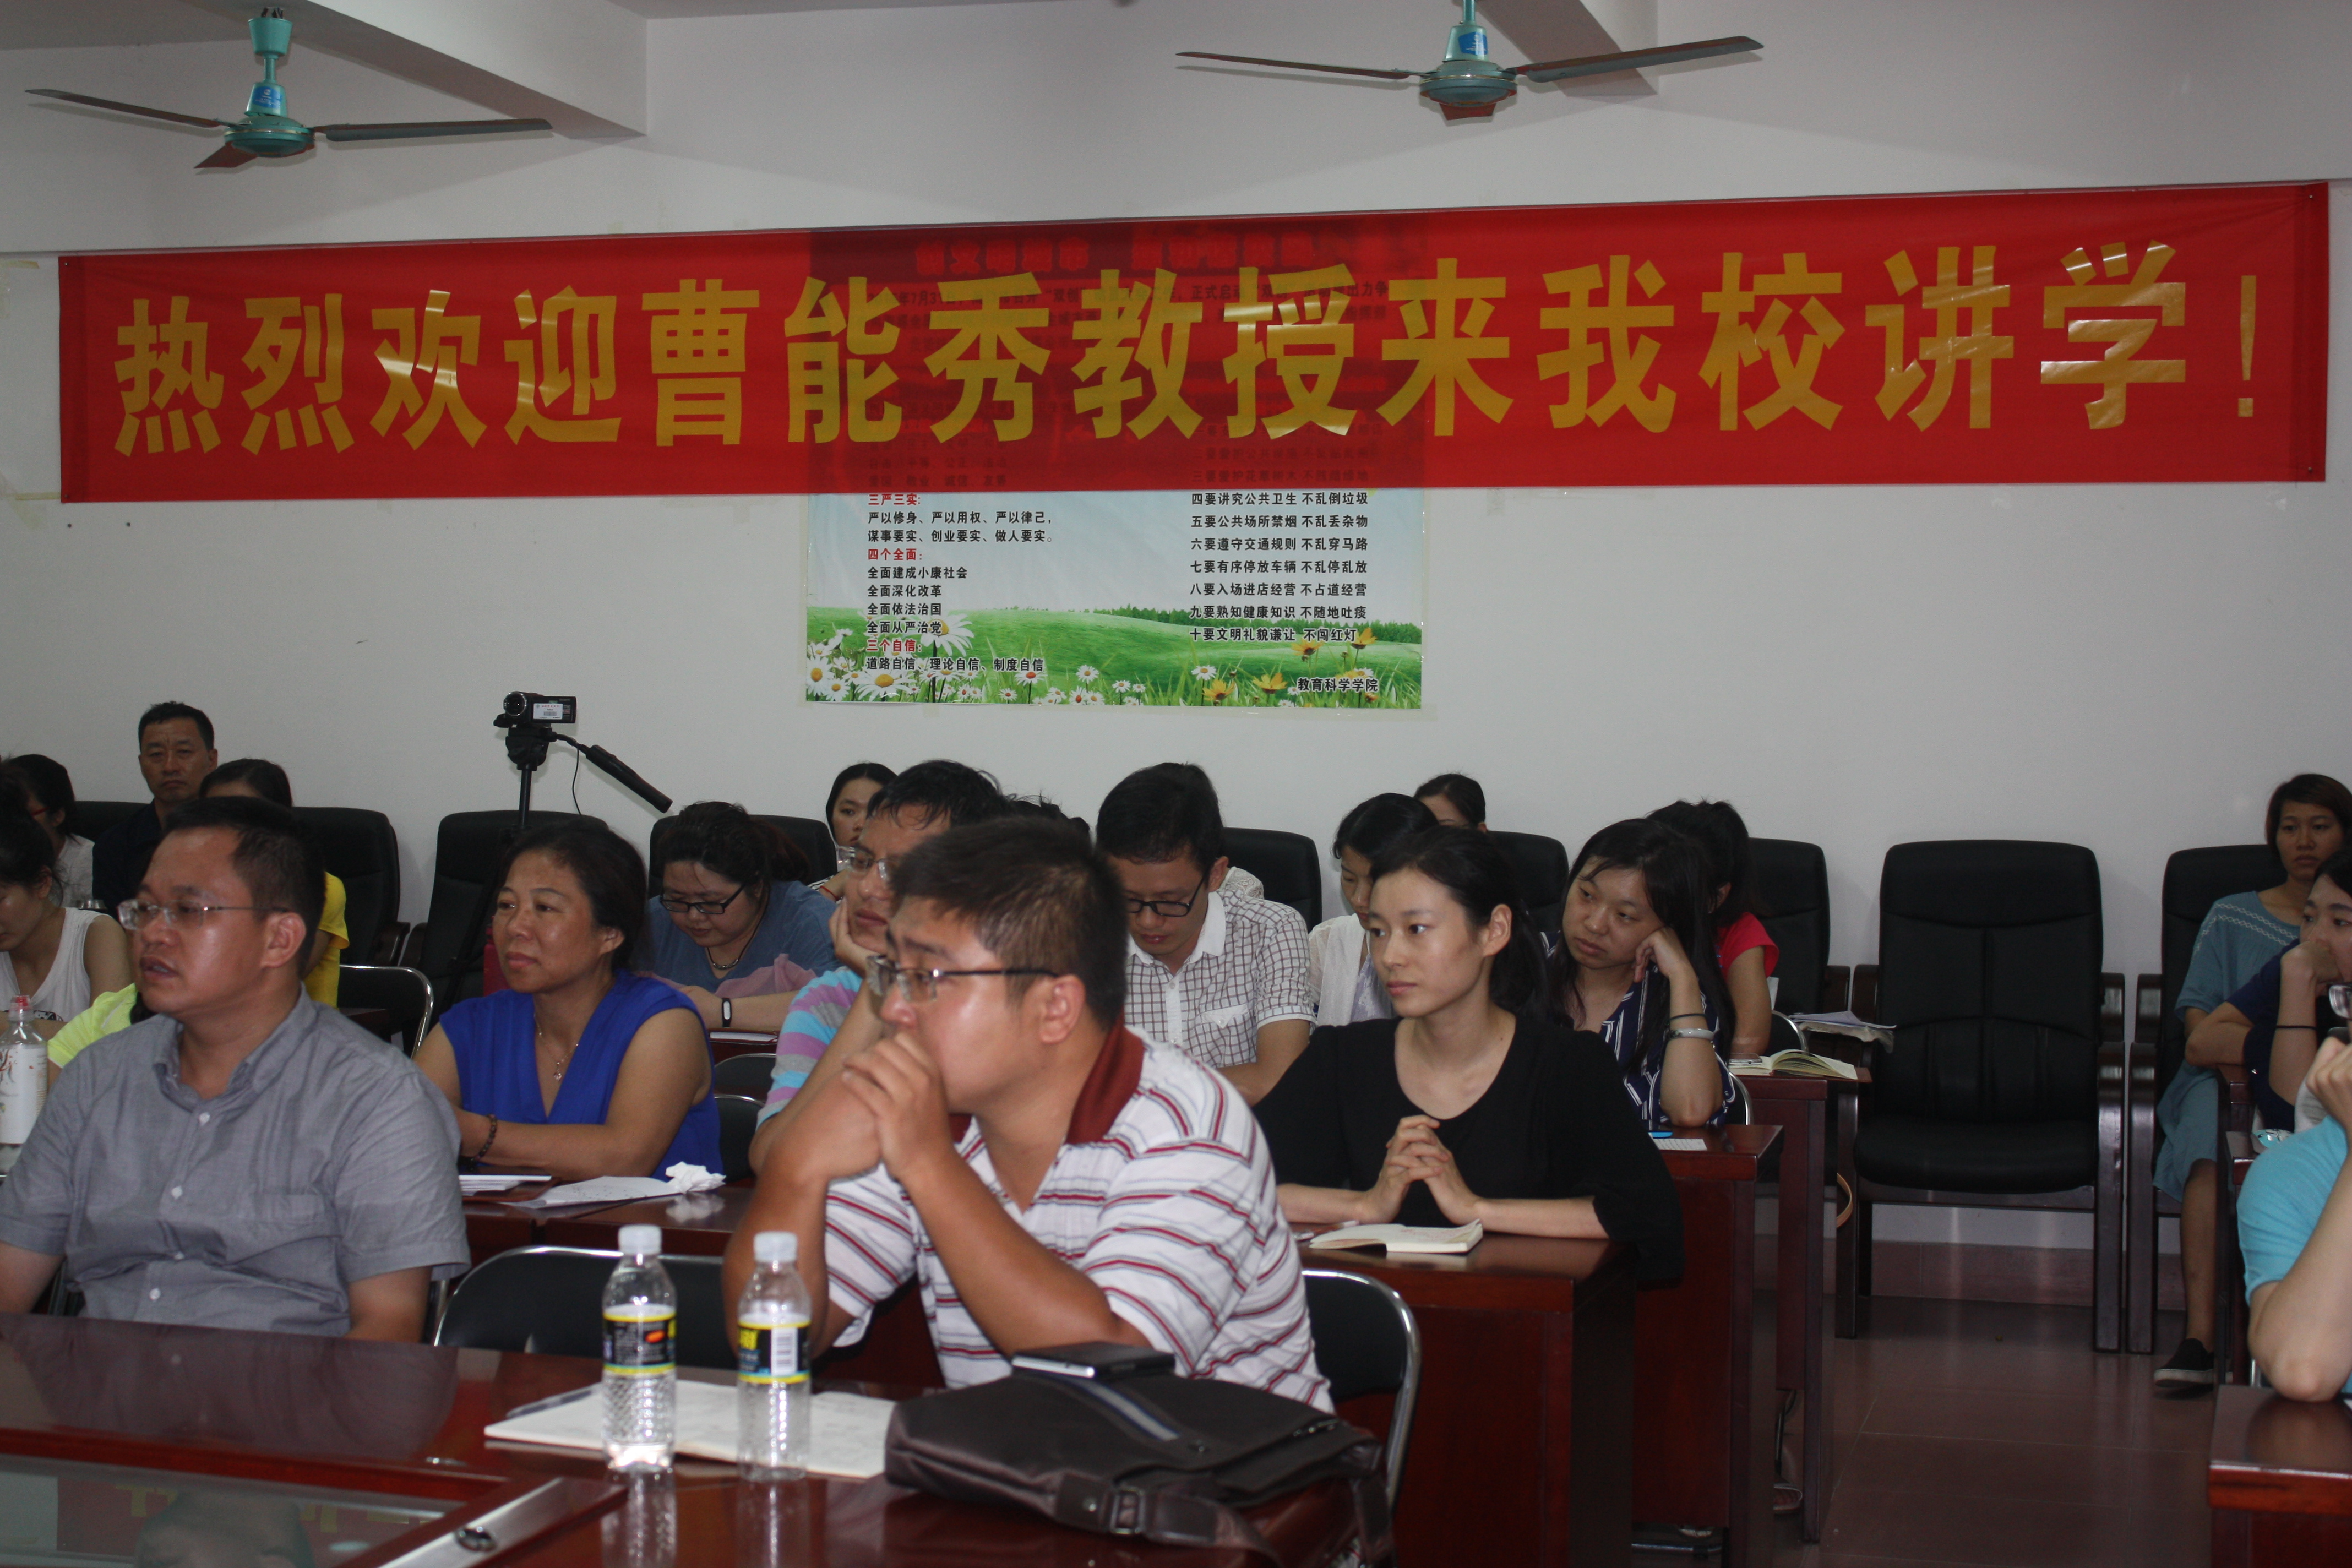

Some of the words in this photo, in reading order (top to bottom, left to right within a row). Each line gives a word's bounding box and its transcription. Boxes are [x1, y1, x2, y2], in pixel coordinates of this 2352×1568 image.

[113, 239, 2256, 458] 热烈欢迎曹能秀教授来我校讲学！
[1191, 493, 1297, 505] 四要讲究公共卫生
[1302, 492, 1368, 505] 不乱倒垃圾
[1191, 515, 1297, 528] 五要公共场所禁烟
[1302, 515, 1368, 527] 不乱丢杂物
[1191, 538, 1297, 551] 六要遵守交通规则
[1301, 538, 1368, 551] 不乱穿马路
[868, 567, 967, 579] 全面建成小康社会
[1190, 560, 1297, 573] 七要有序停放车辆
[1301, 560, 1367, 573] 不乱停乱放
[867, 585, 941, 597] 全面深化改革
[1190, 584, 1295, 596] 八要入场进店经营
[1301, 584, 1367, 596] 不占道经营
[867, 603, 941, 616] 全面依法治国
[1190, 606, 1295, 619] 九要熟知健康知识
[1300, 606, 1366, 619] 不随地吐痰
[867, 621, 941, 634] 全面从严治党
[1190, 628, 1295, 641] 十要文明礼貌谦让
[1304, 628, 1357, 641] 不闯红灯
[867, 658, 1044, 672] 道路自信、理论自信、制度自信
[1298, 678, 1378, 692] 教育科学学院
